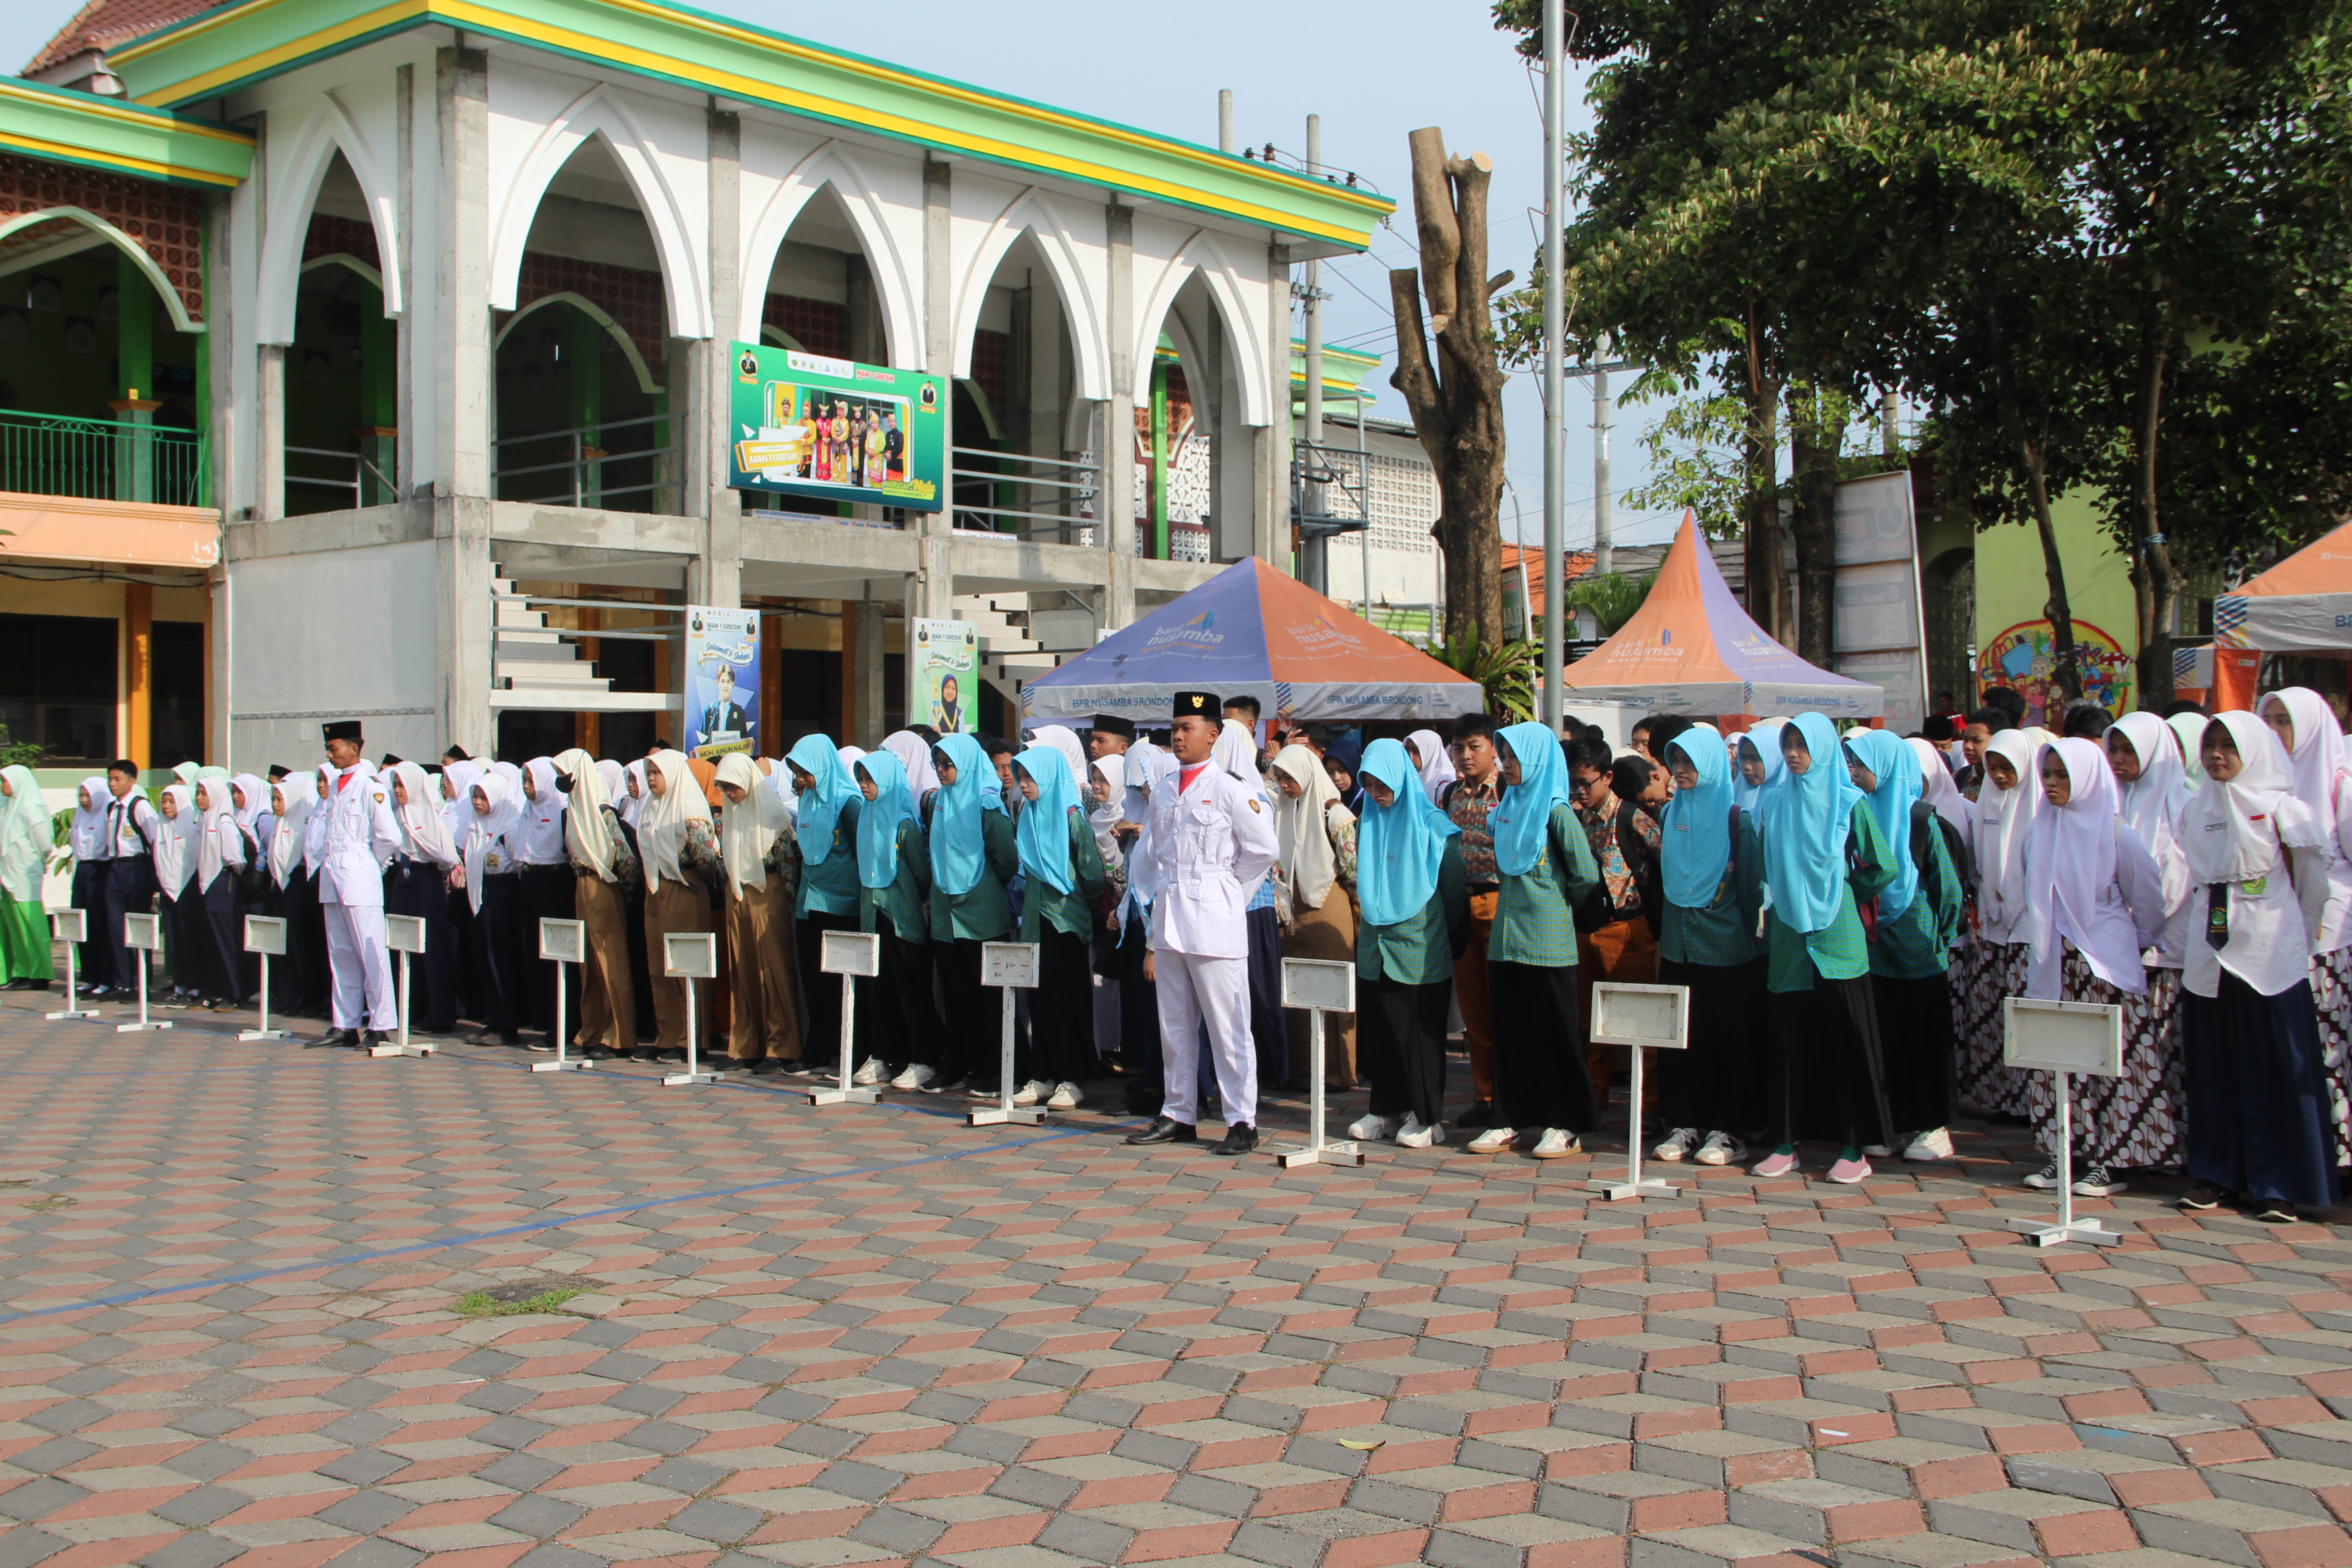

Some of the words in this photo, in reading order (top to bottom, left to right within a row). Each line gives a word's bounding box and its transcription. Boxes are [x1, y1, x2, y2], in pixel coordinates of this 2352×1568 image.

[856, 369, 869, 377] MAN
[874, 372, 895, 382] GRESIK
[750, 454, 768, 464] MAN
[769, 454, 772, 462] 1
[773, 452, 799, 461] GRESIK
[909, 478, 936, 496] Maju
[1154, 624, 1184, 635] bank
[1284, 623, 1317, 634] bank
[1147, 630, 1224, 646] nusamba
[706, 642, 730, 655] Selamat
[1615, 639, 1643, 649] bank
[1610, 645, 1684, 657] nusamba
[931, 651, 951, 663] Selamat
[1073, 699, 1089, 708] BPR
[1092, 698, 1132, 707] NUSAMBA
[1134, 697, 1174, 706] BRONDON
[1327, 695, 1343, 704] BPR
[1345, 696, 1381, 704] NUSAMBA
[1382, 696, 1423, 705] BRONDONG
[1788, 696, 1812, 705] NUSAMBA
[1813, 698, 1840, 706] BRONDONG
[715, 746, 733, 755] AINUN
